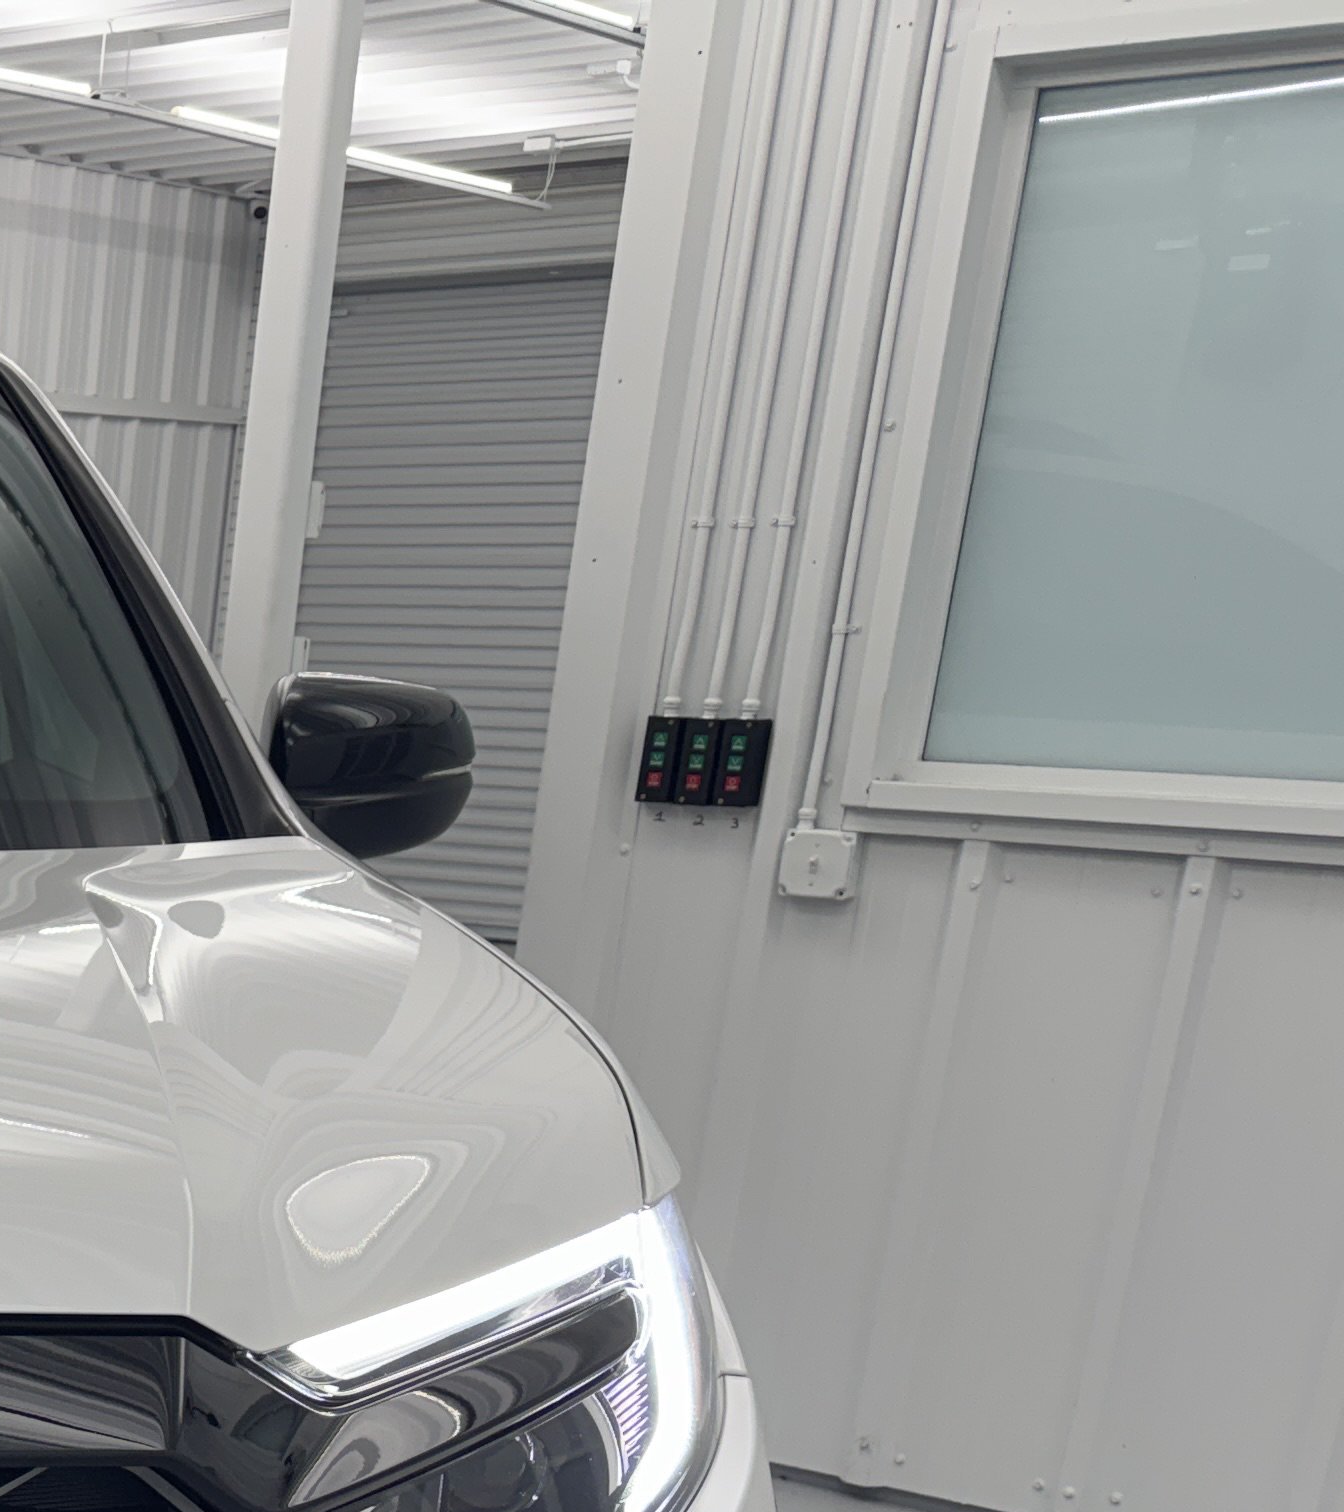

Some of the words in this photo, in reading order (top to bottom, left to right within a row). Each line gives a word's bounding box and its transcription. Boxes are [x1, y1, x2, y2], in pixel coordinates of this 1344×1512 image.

[653, 811, 666, 822] 1
[693, 814, 705, 826] 2
[730, 817, 739, 829] 3
